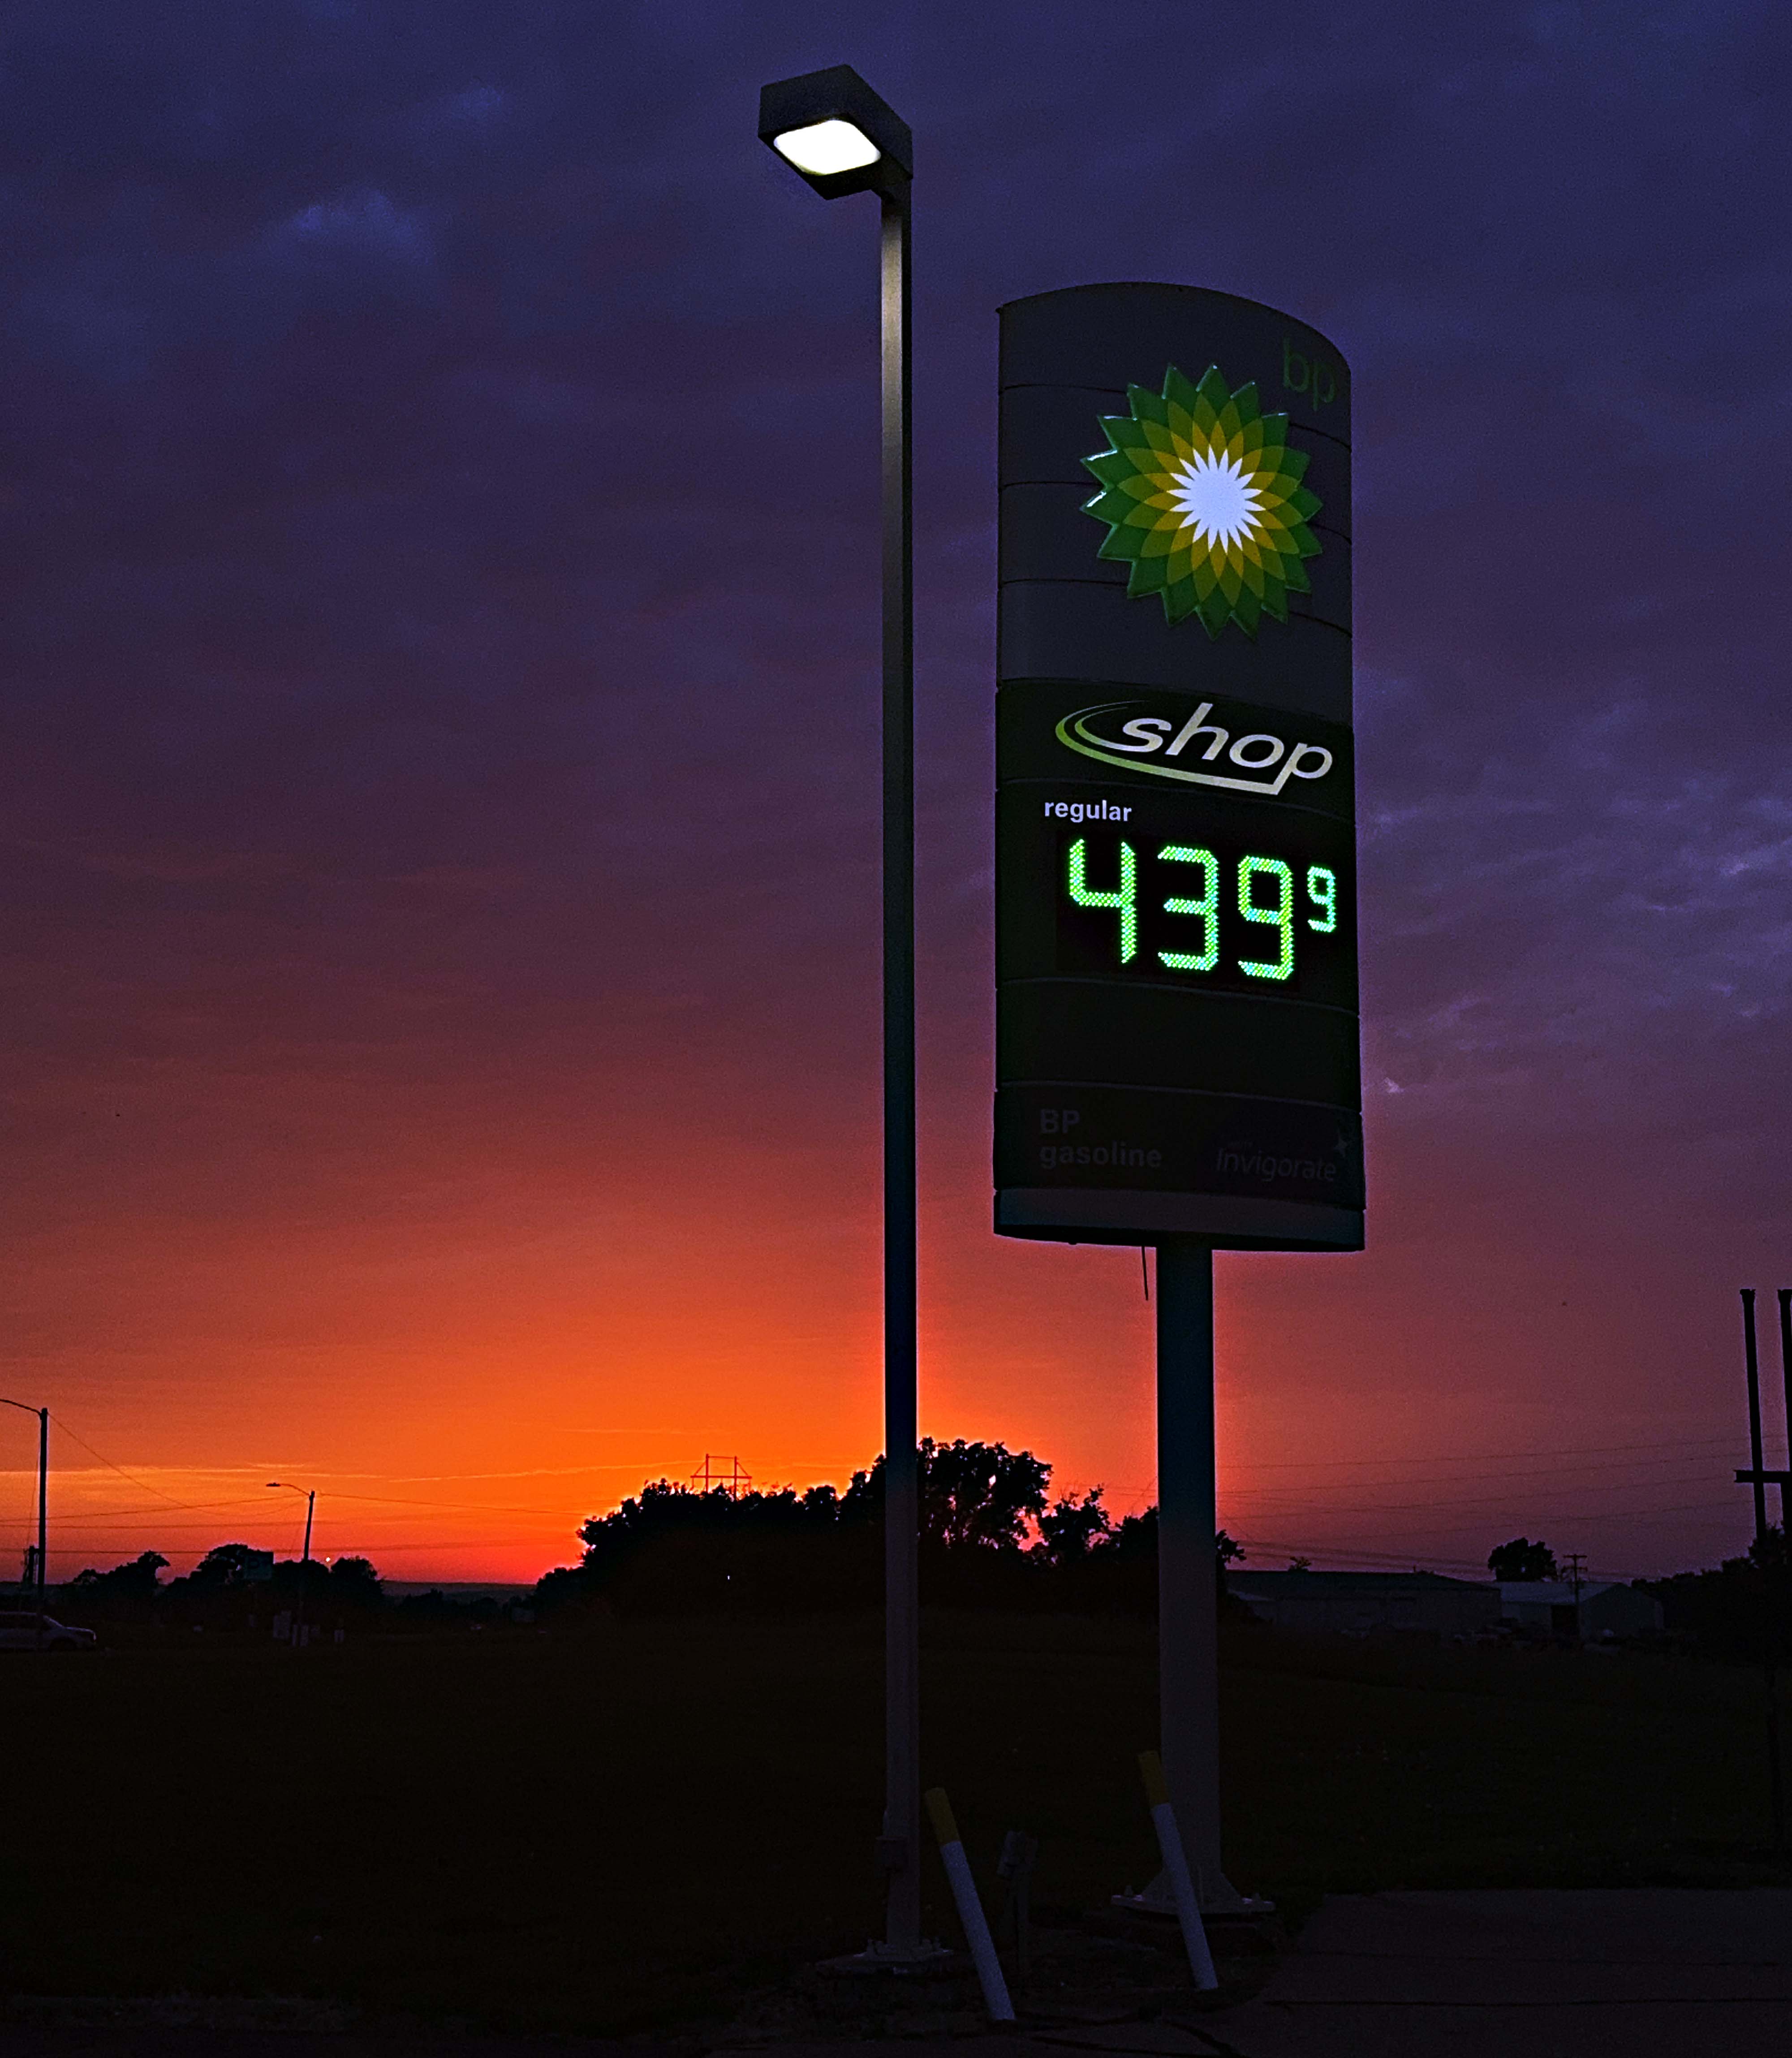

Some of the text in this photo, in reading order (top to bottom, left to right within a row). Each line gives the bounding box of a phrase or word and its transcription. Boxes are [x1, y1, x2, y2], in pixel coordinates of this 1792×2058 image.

[1283, 336, 1336, 412] bp
[1121, 702, 1333, 795] shop
[1044, 799, 1132, 823] regular
[1040, 1108, 1081, 1134] BP
[1039, 1140, 1163, 1169] gasoline
[1216, 1147, 1337, 1183] Invigorate
